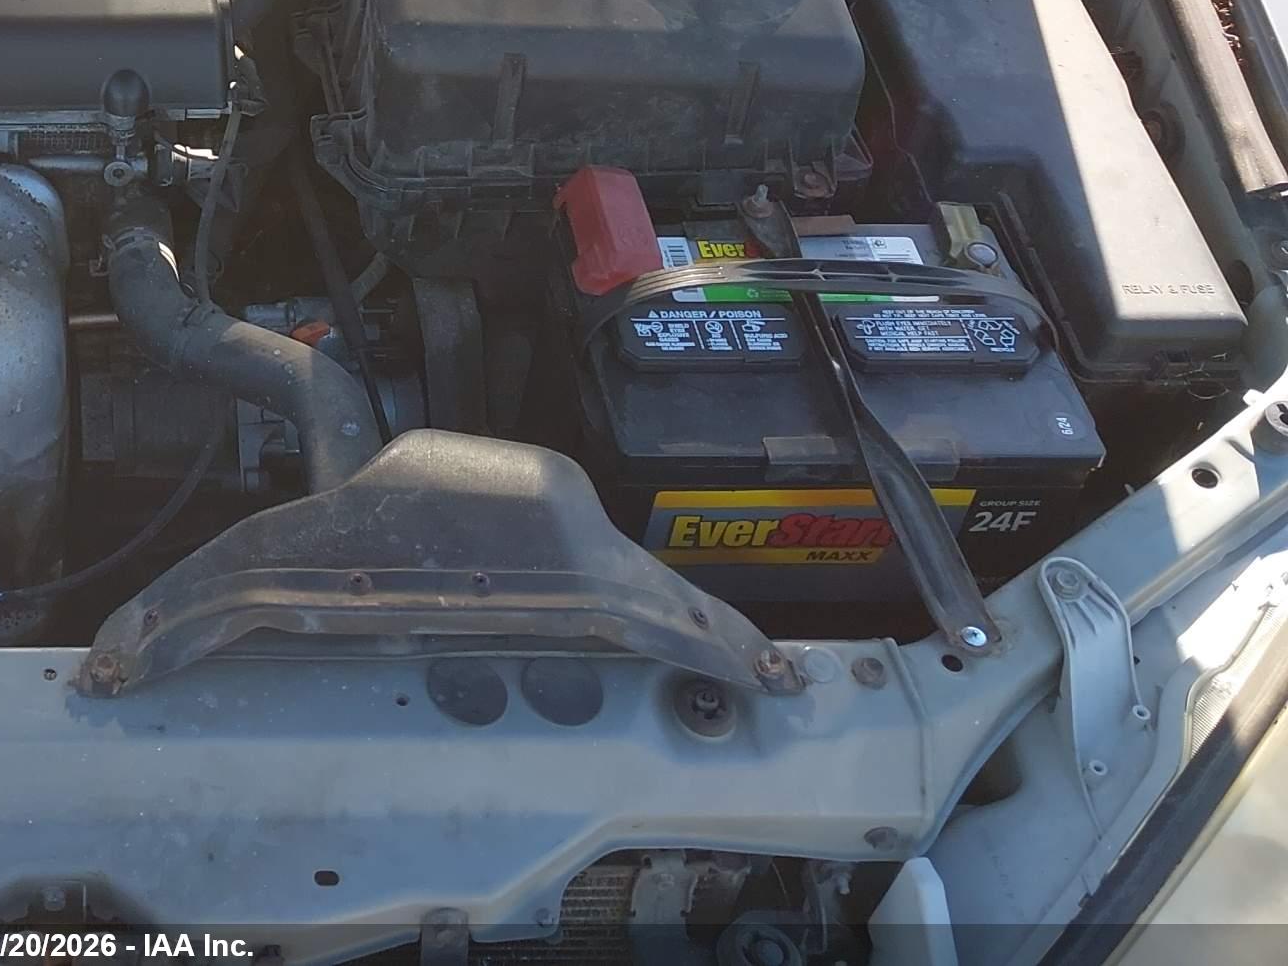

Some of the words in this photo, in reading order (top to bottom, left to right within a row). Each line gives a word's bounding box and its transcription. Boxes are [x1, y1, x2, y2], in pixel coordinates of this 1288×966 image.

[696, 239, 756, 259] Ever
[1122, 284, 1164, 295] RELAY
[1180, 284, 1216, 295] FUSE
[660, 310, 708, 318] DANGER
[719, 310, 762, 318] POISON
[1056, 417, 1074, 435] 6/24
[968, 511, 1037, 532] 24F
[806, 550, 873, 561] MAXX
